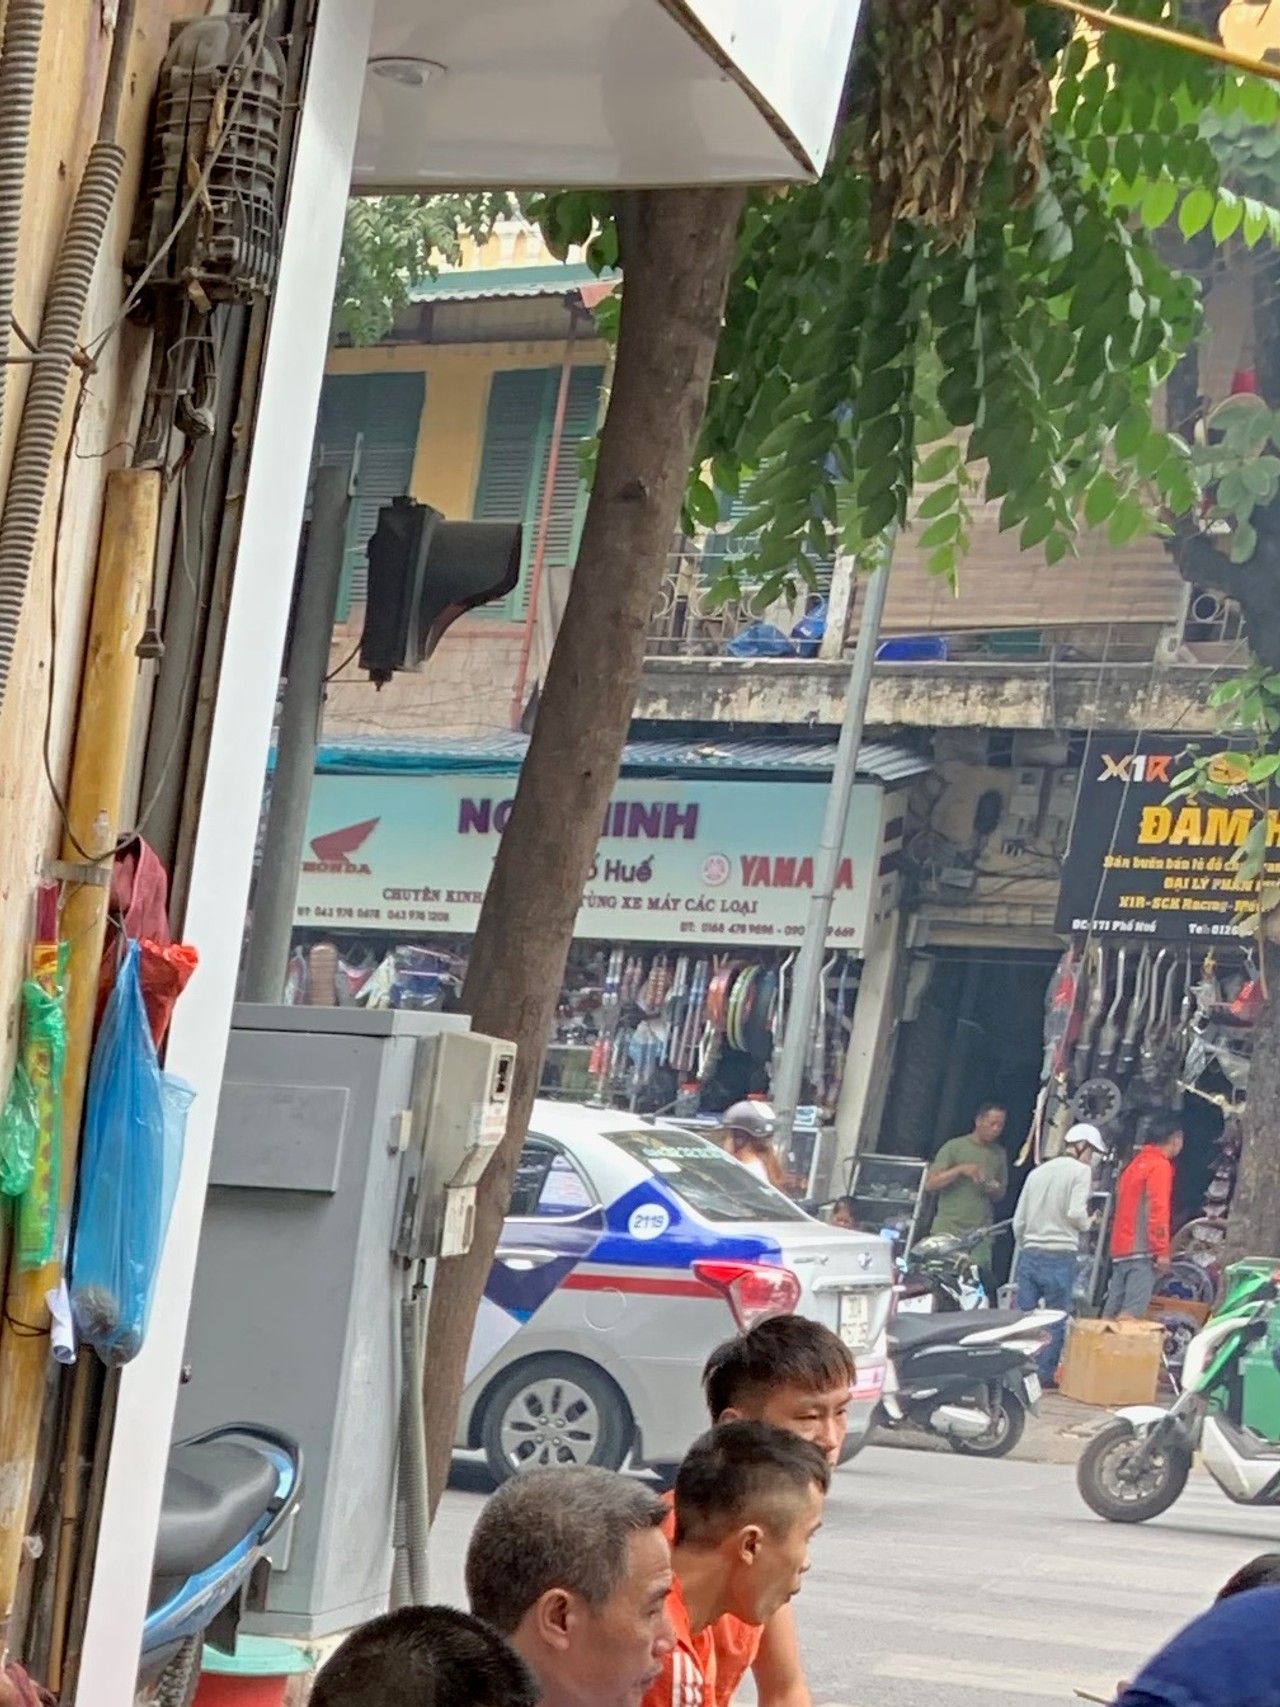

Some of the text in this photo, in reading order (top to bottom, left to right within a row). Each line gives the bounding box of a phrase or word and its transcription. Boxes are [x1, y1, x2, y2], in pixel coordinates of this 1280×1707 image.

[1097, 754, 1173, 783] X1R
[303, 861, 373, 875] HONDA
[604, 854, 655, 883] Huế
[740, 855, 853, 889] YAMAA
[382, 886, 483, 904] CHUYÊN KINH
[621, 895, 643, 910] XE
[647, 892, 681, 912] MÁY
[685, 894, 716, 912] CÁC
[720, 899, 758, 916] LOẠI
